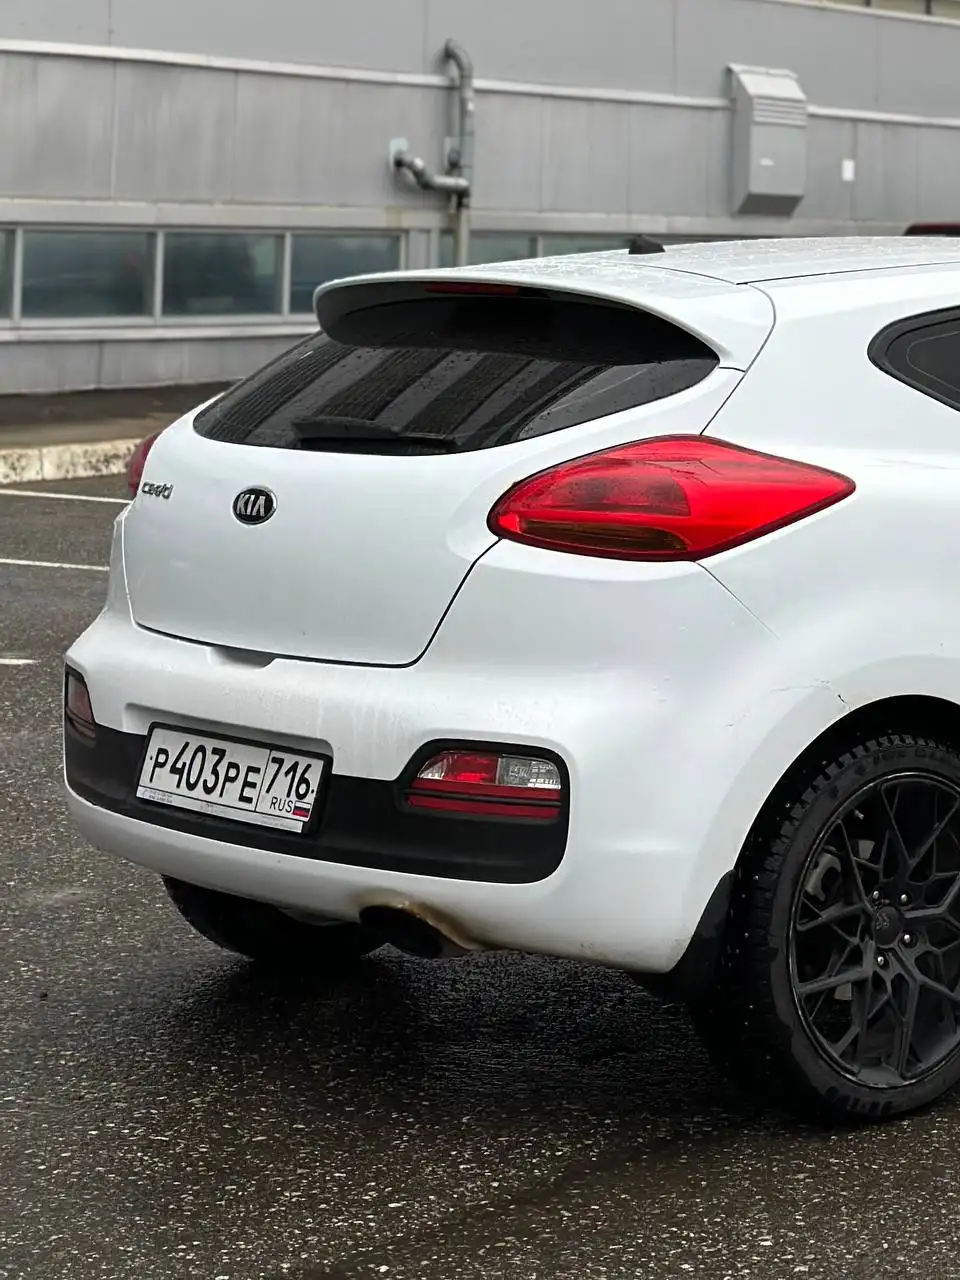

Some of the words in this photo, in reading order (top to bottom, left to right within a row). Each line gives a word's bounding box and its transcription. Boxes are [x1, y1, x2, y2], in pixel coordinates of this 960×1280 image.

[237, 493, 265, 517] KIA
[265, 756, 313, 801] 716
[269, 796, 294, 814] RUS
